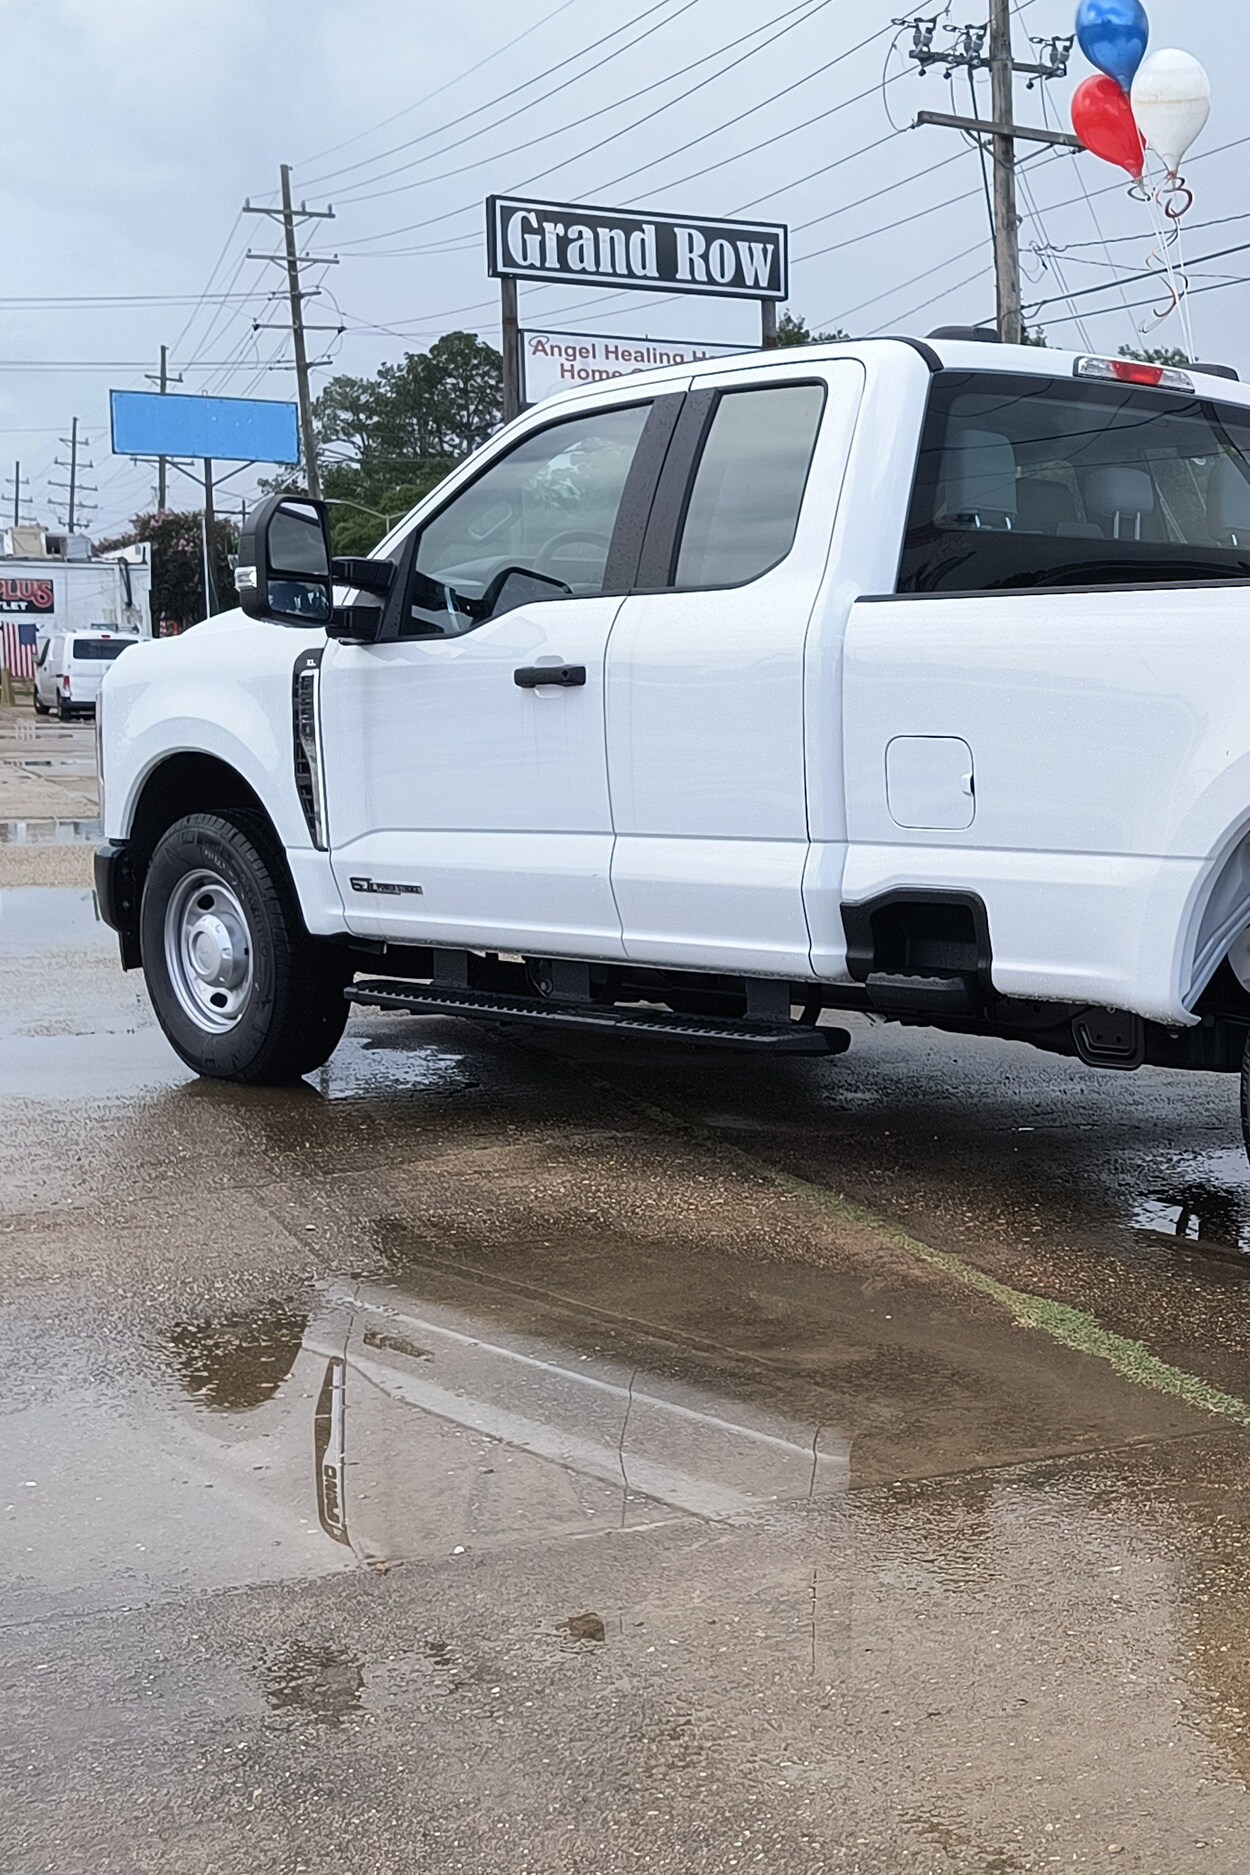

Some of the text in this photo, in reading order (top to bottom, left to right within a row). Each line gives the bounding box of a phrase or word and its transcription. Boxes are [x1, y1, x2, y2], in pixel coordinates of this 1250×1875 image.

[506, 210, 775, 288] Grand Row
[531, 339, 597, 362] Angel
[604, 344, 685, 365] Healing
